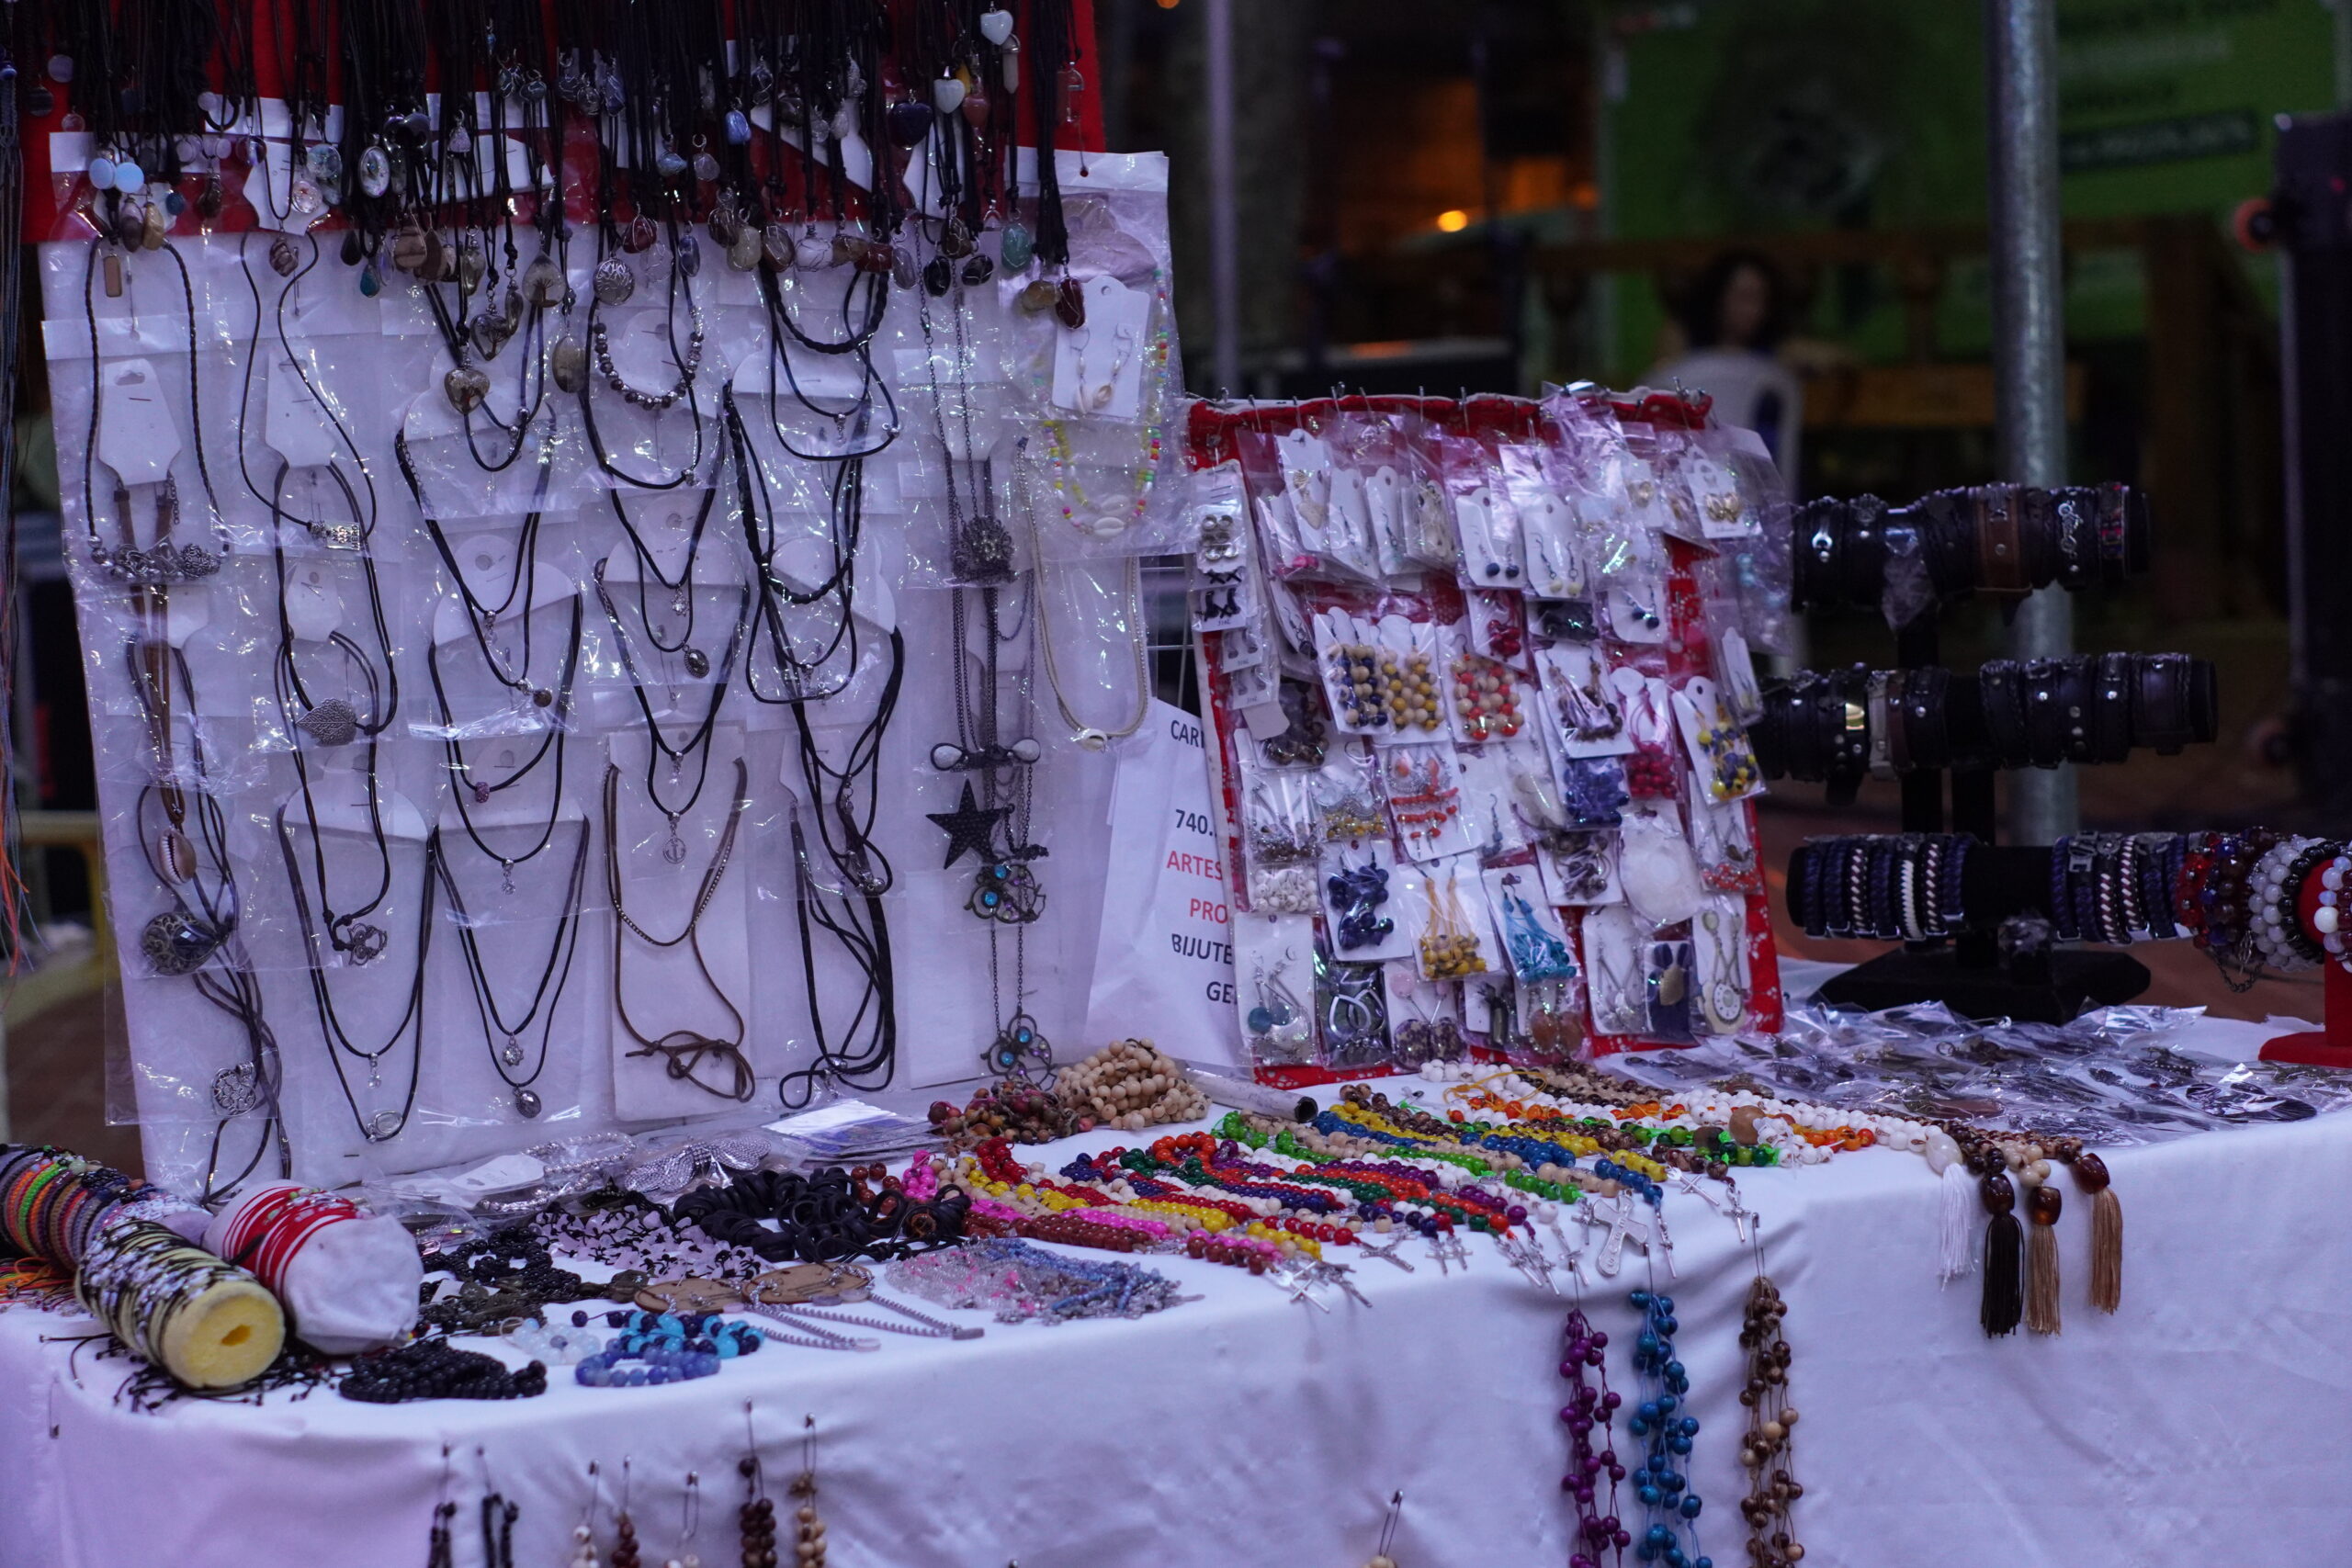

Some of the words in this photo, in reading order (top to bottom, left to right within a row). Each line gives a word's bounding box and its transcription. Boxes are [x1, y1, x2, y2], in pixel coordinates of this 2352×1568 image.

[1166, 850, 1223, 881] ARTES
[1190, 897, 1229, 924] PRO
[1171, 933, 1233, 965] BIJUTE
[1206, 981, 1238, 1005] GE
